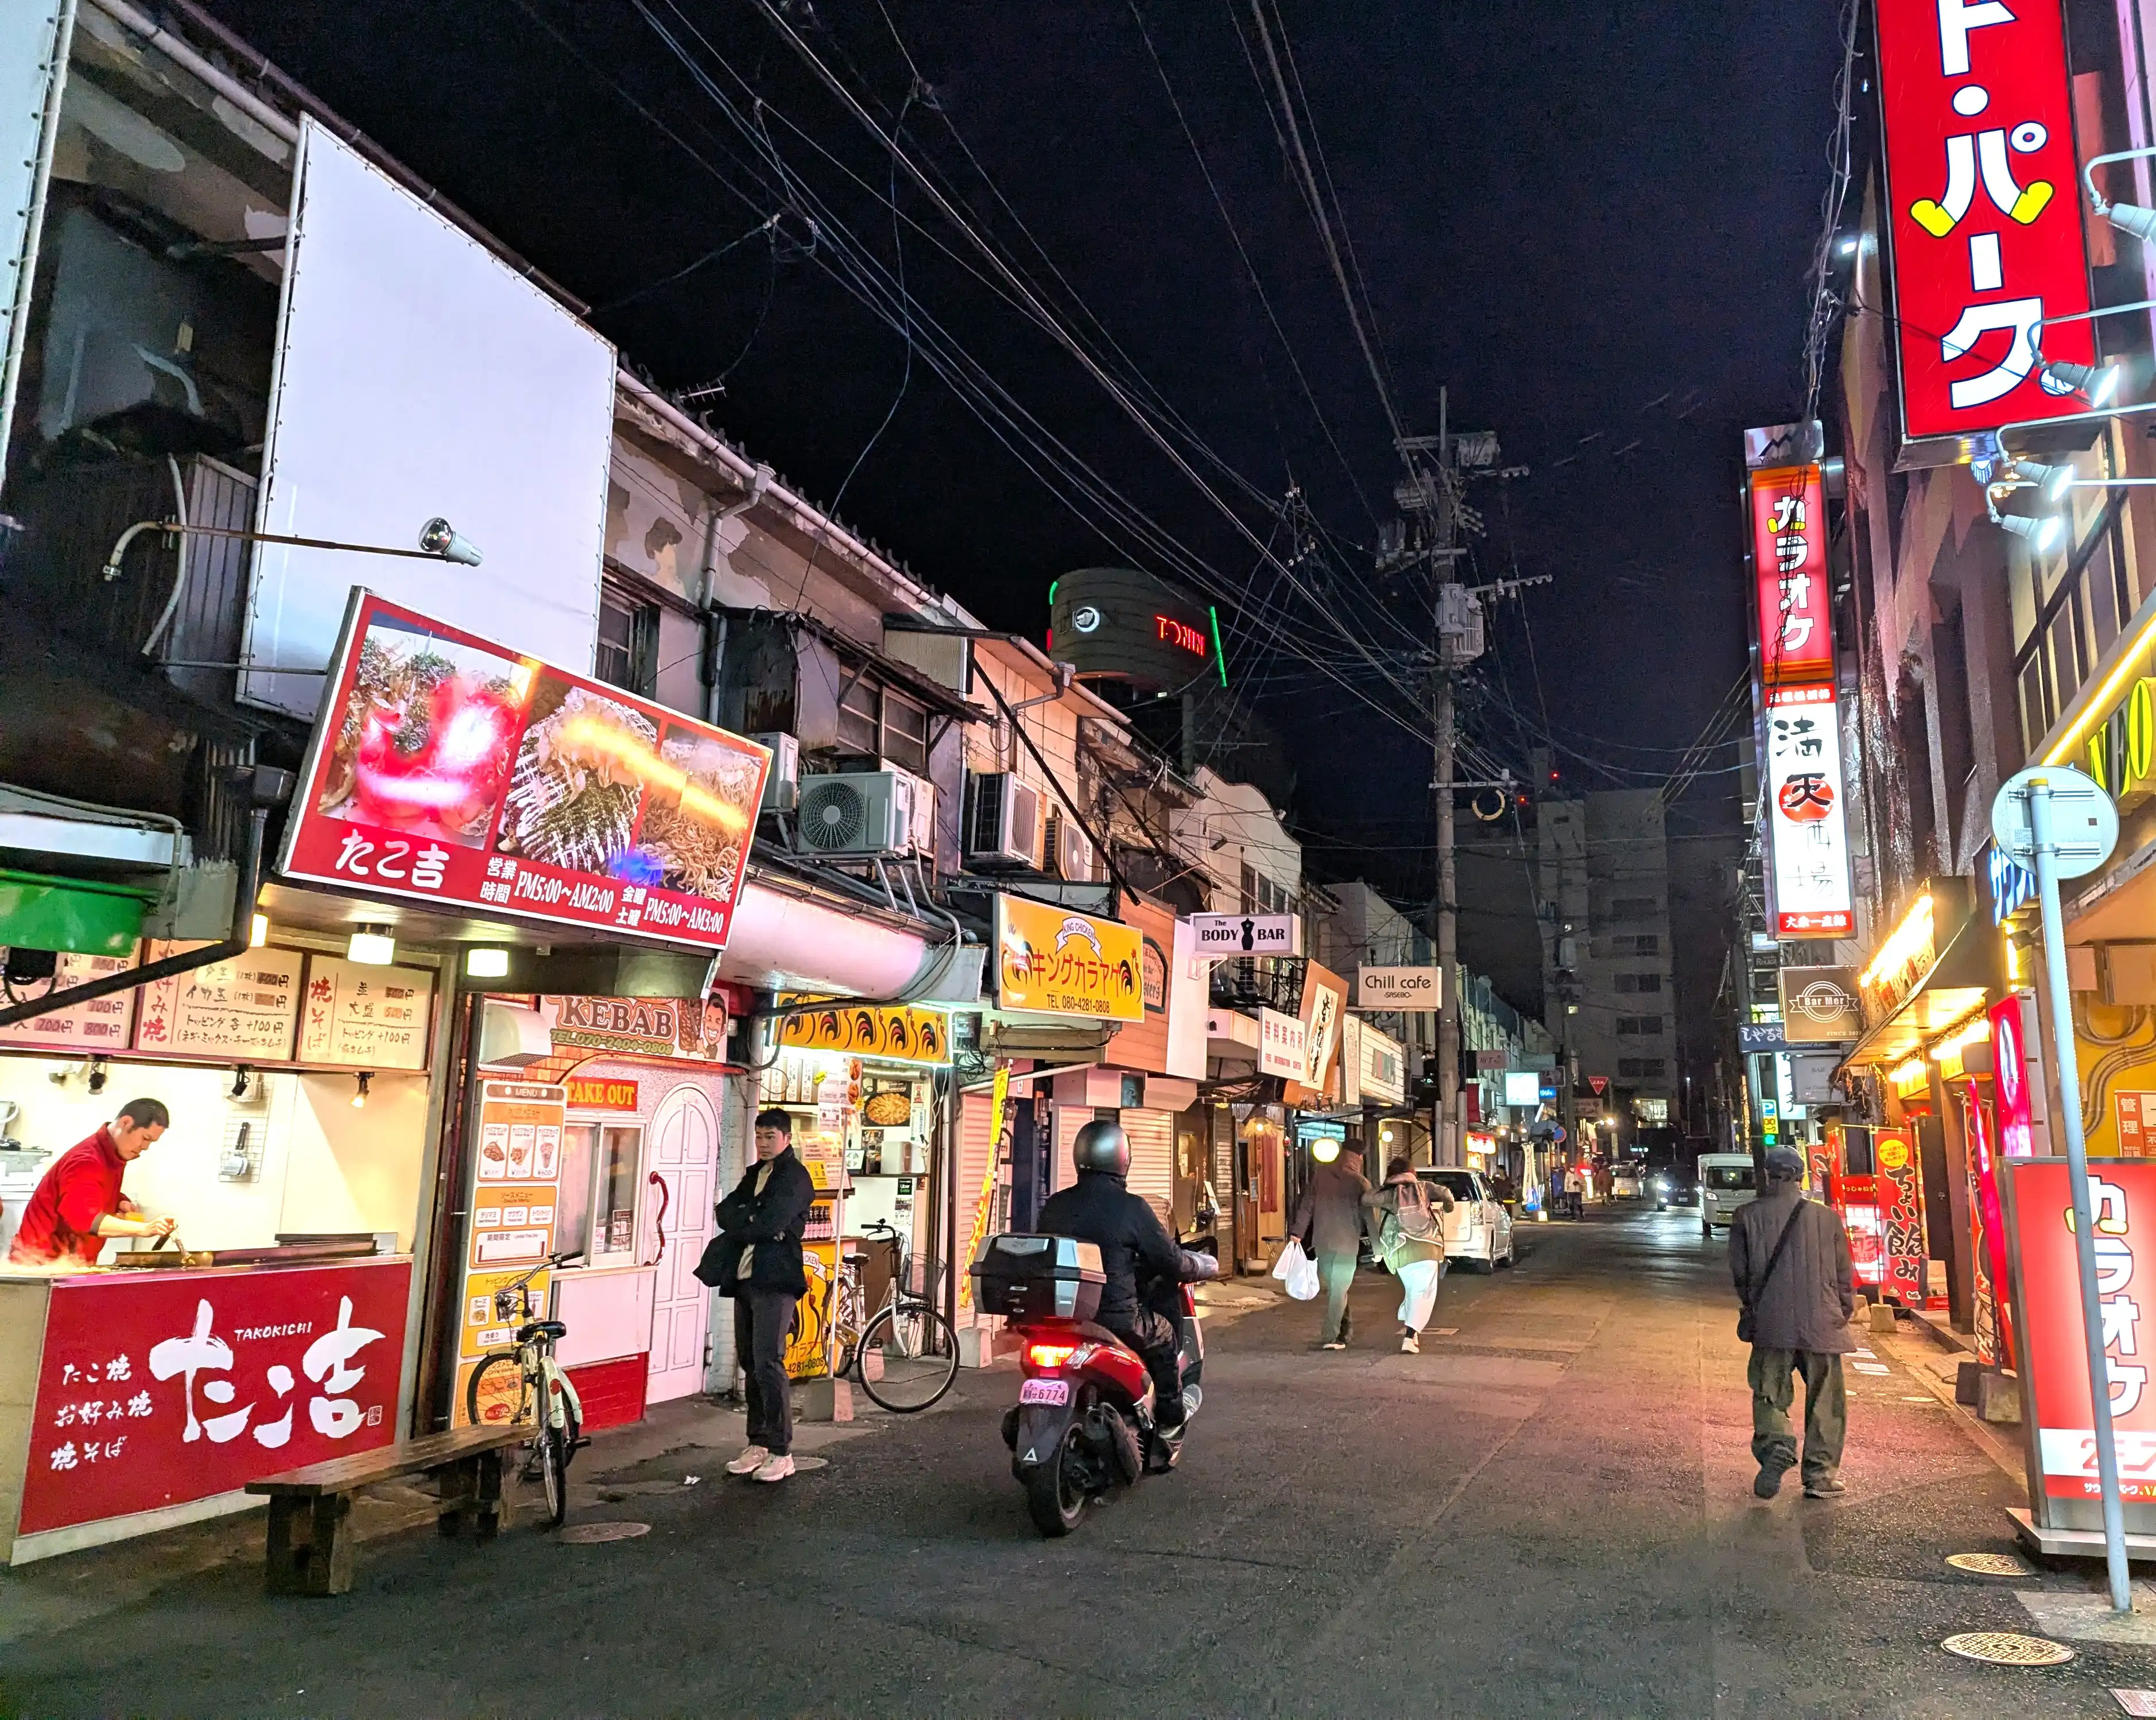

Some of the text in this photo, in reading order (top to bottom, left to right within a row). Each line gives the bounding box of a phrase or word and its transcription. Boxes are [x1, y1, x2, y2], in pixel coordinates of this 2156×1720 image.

[1767, 496, 1814, 652] カラオケ
[335, 829, 450, 889] たこ吉
[487, 857, 517, 879] 営業
[480, 881, 510, 904] 時間
[622, 886, 646, 905] 金曜
[615, 908, 640, 928] 土曜
[1064, 922, 1095, 940] KING CHICKEN
[1201, 928, 1285, 941] BODY BAR
[1033, 948, 1120, 998] キングカラアゲ
[1365, 975, 1431, 989] Chill cafe
[1047, 994, 1110, 1013] TEL 080-4281-0808
[1805, 997, 1844, 1006] Bar Mer
[560, 995, 674, 1039] KEBAB
[514, 1088, 537, 1097] MENU
[566, 1081, 635, 1105] TAKE OUT
[1762, 1103, 1773, 1113] P
[2120, 1098, 2139, 1134] 管理
[234, 1321, 313, 1342] TAKOKICHI
[62, 1353, 133, 1386] たこ焼
[1038, 1389, 1065, 1401] 6774
[55, 1389, 154, 1428] お好み焼
[50, 1435, 127, 1471] 焼そば
